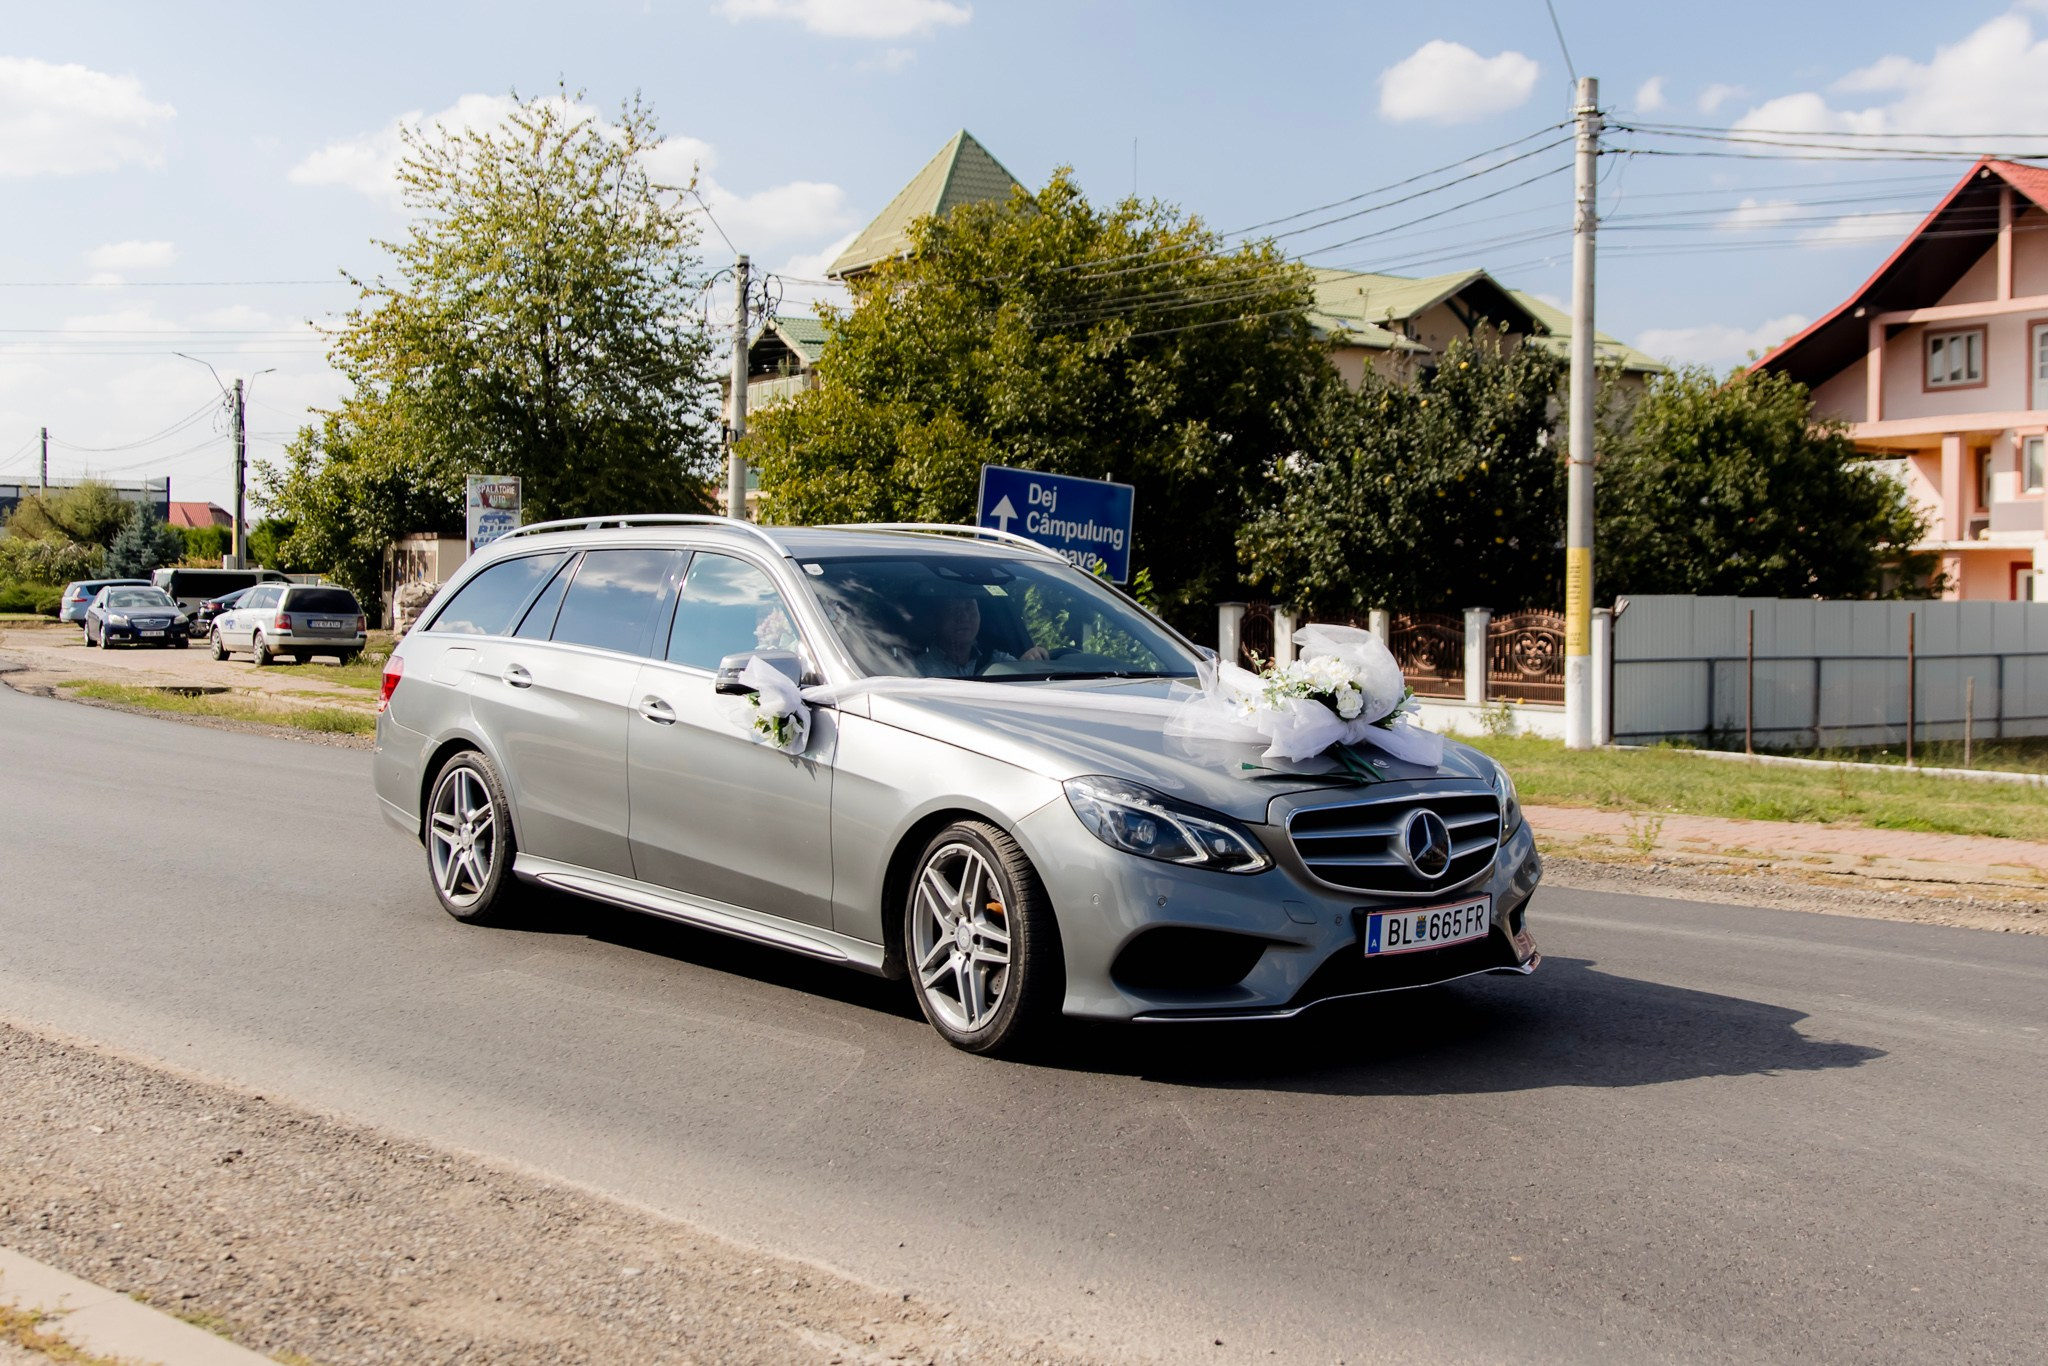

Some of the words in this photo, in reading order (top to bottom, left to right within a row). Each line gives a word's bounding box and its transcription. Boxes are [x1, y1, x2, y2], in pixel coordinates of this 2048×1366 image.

[489, 495, 506, 504] AUTO
[1028, 483, 1057, 513] Dej
[1026, 511, 1124, 551] Câmpulung
[1371, 939, 1378, 948] A
[1387, 918, 1412, 946] BL
